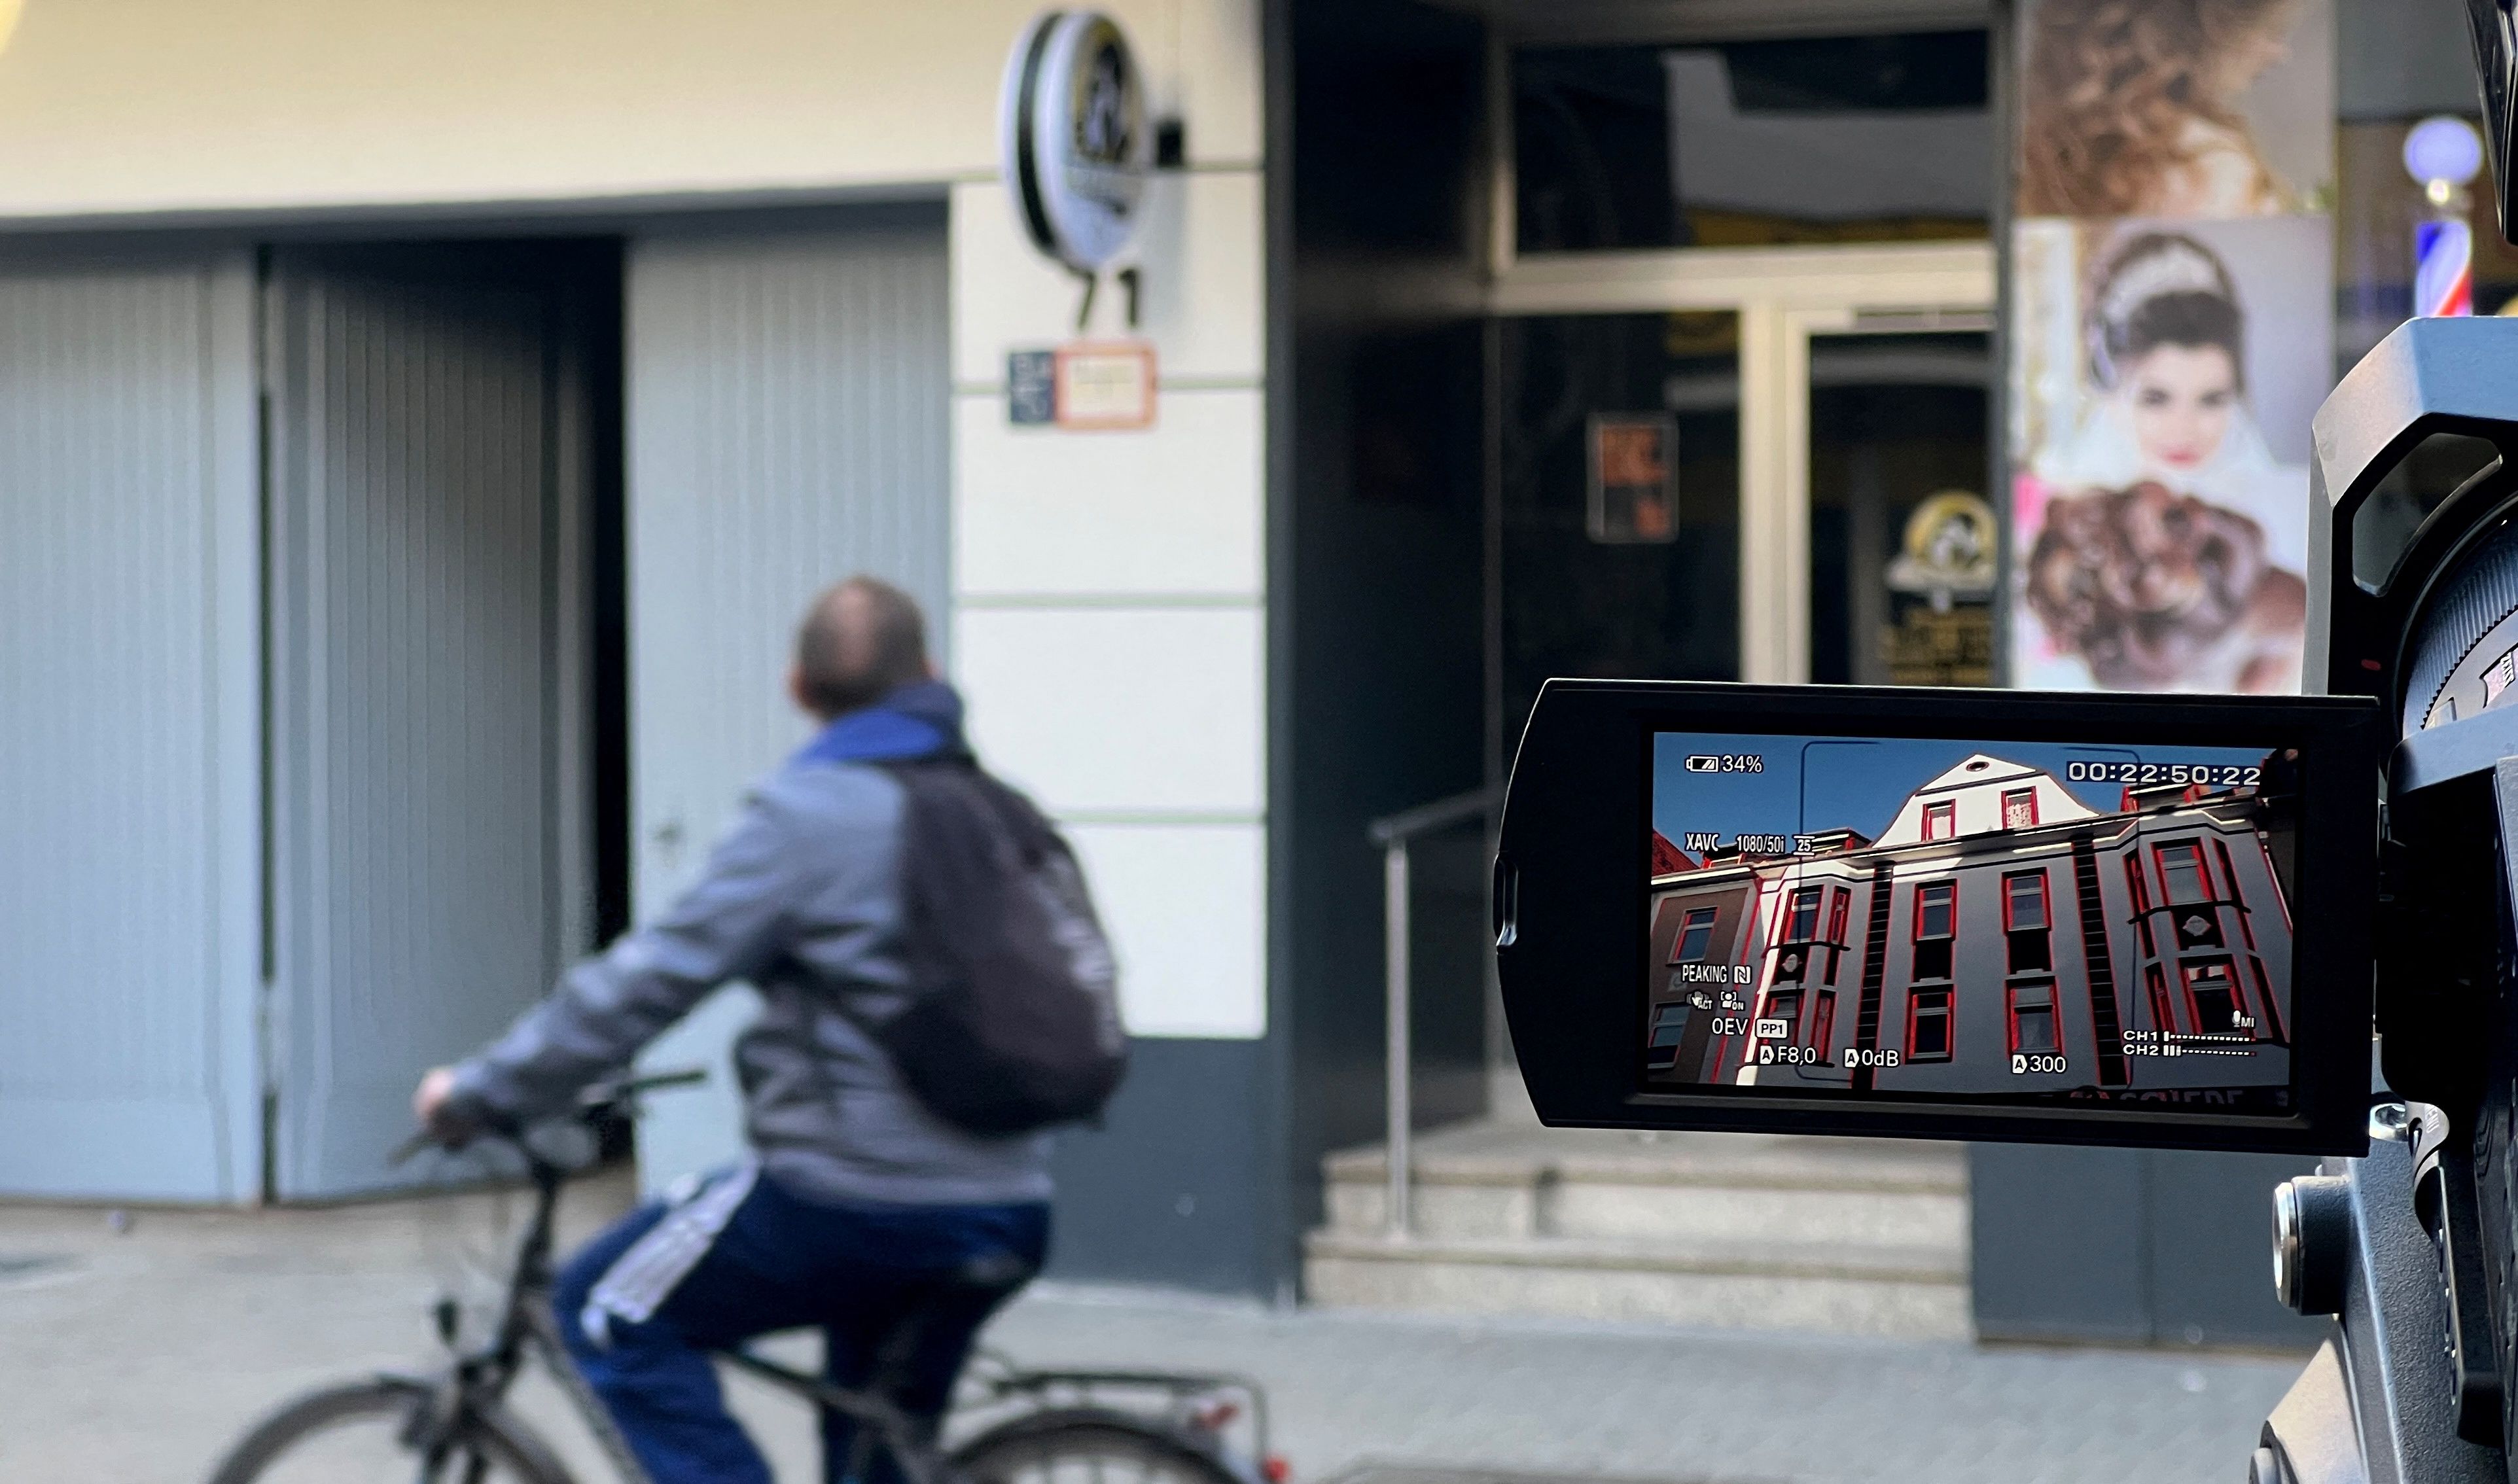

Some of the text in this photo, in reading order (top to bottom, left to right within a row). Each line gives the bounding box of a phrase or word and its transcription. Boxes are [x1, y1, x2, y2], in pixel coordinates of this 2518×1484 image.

[1722, 755, 1762, 773] 34%
[2068, 762, 2261, 786] 00:22:50:22
[1686, 833, 1811, 853] XAVC 1080/50i 25
[1682, 964, 1728, 983] PEAKING
[1698, 1000, 1745, 1010] ACT ON
[1761, 1023, 1783, 1034] PP1
[2123, 1030, 2158, 1042] CH1
[2122, 1044, 2159, 1056] CH2
[1777, 1046, 1817, 1066] F8,0
[1862, 1049, 1899, 1067] 0dB
[2029, 1055, 2066, 1073] 300
